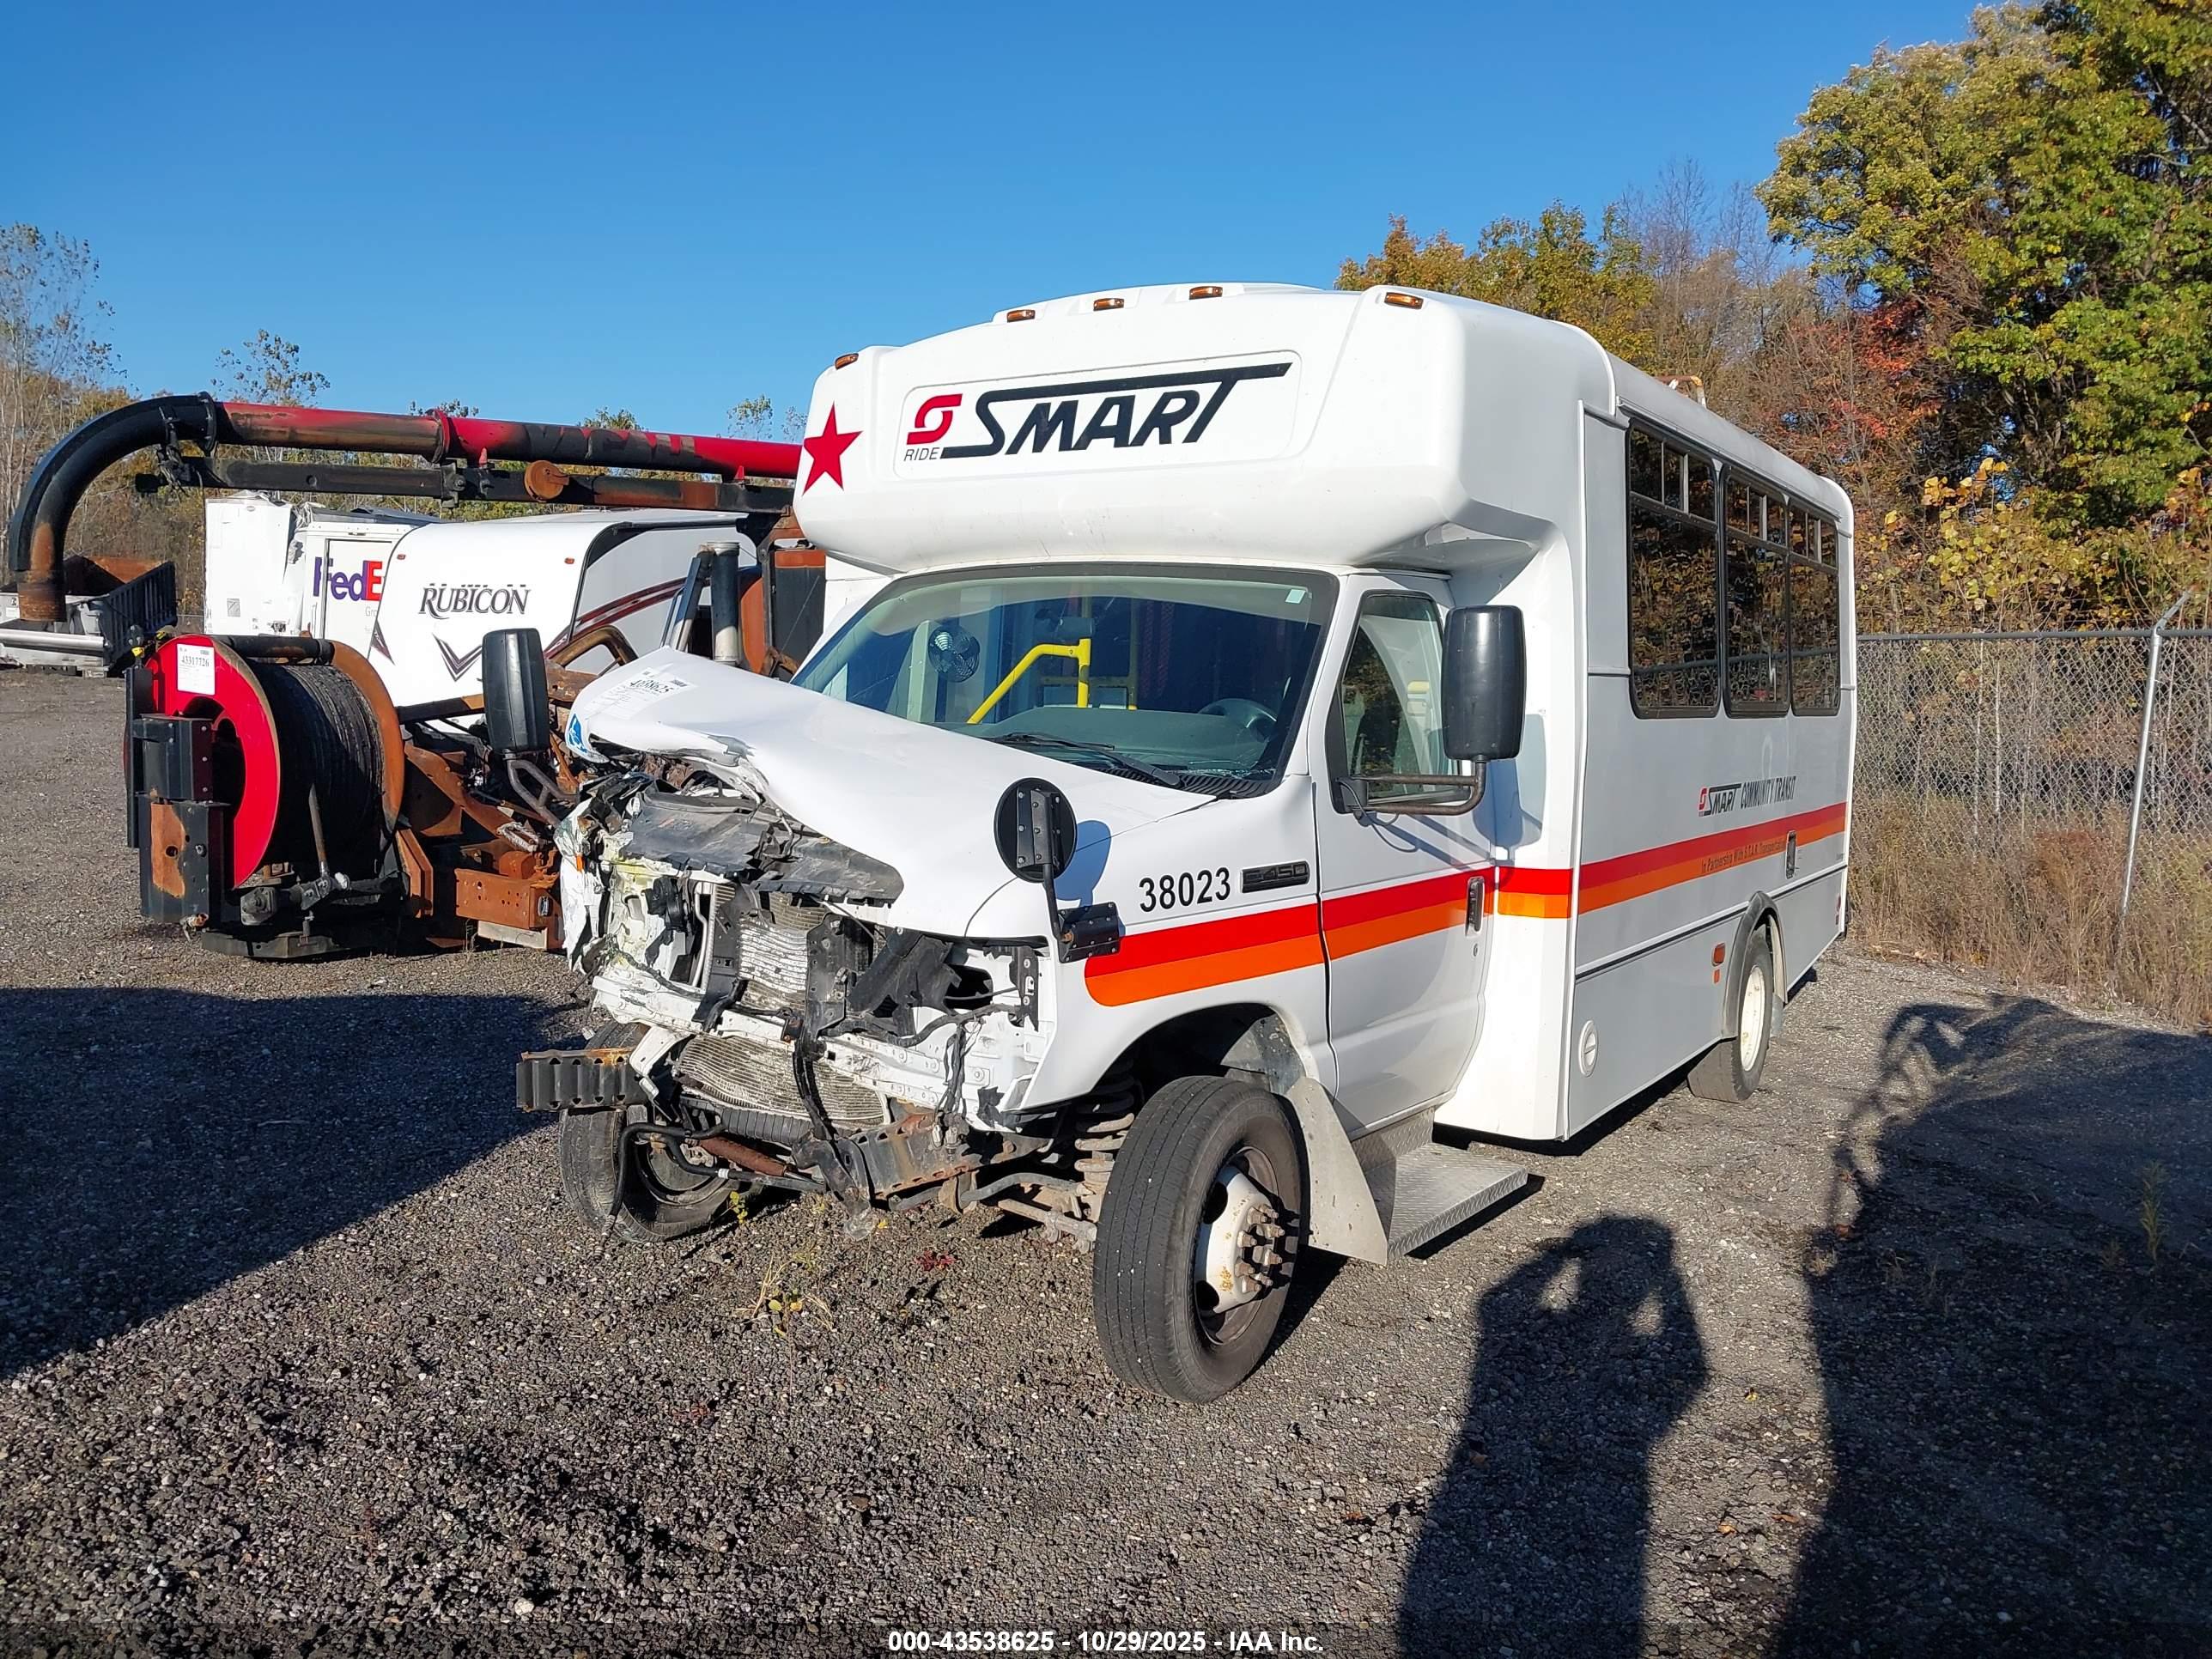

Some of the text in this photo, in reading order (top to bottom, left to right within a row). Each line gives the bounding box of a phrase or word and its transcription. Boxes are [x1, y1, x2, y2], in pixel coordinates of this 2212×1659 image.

[903, 362, 1293, 462] RIDE SMART
[313, 556, 386, 601] FedE
[417, 585, 532, 619] RUBICON
[1704, 775, 1796, 816] SMART COMMUNITY TRANSIT
[1139, 866, 1231, 913] 38023
